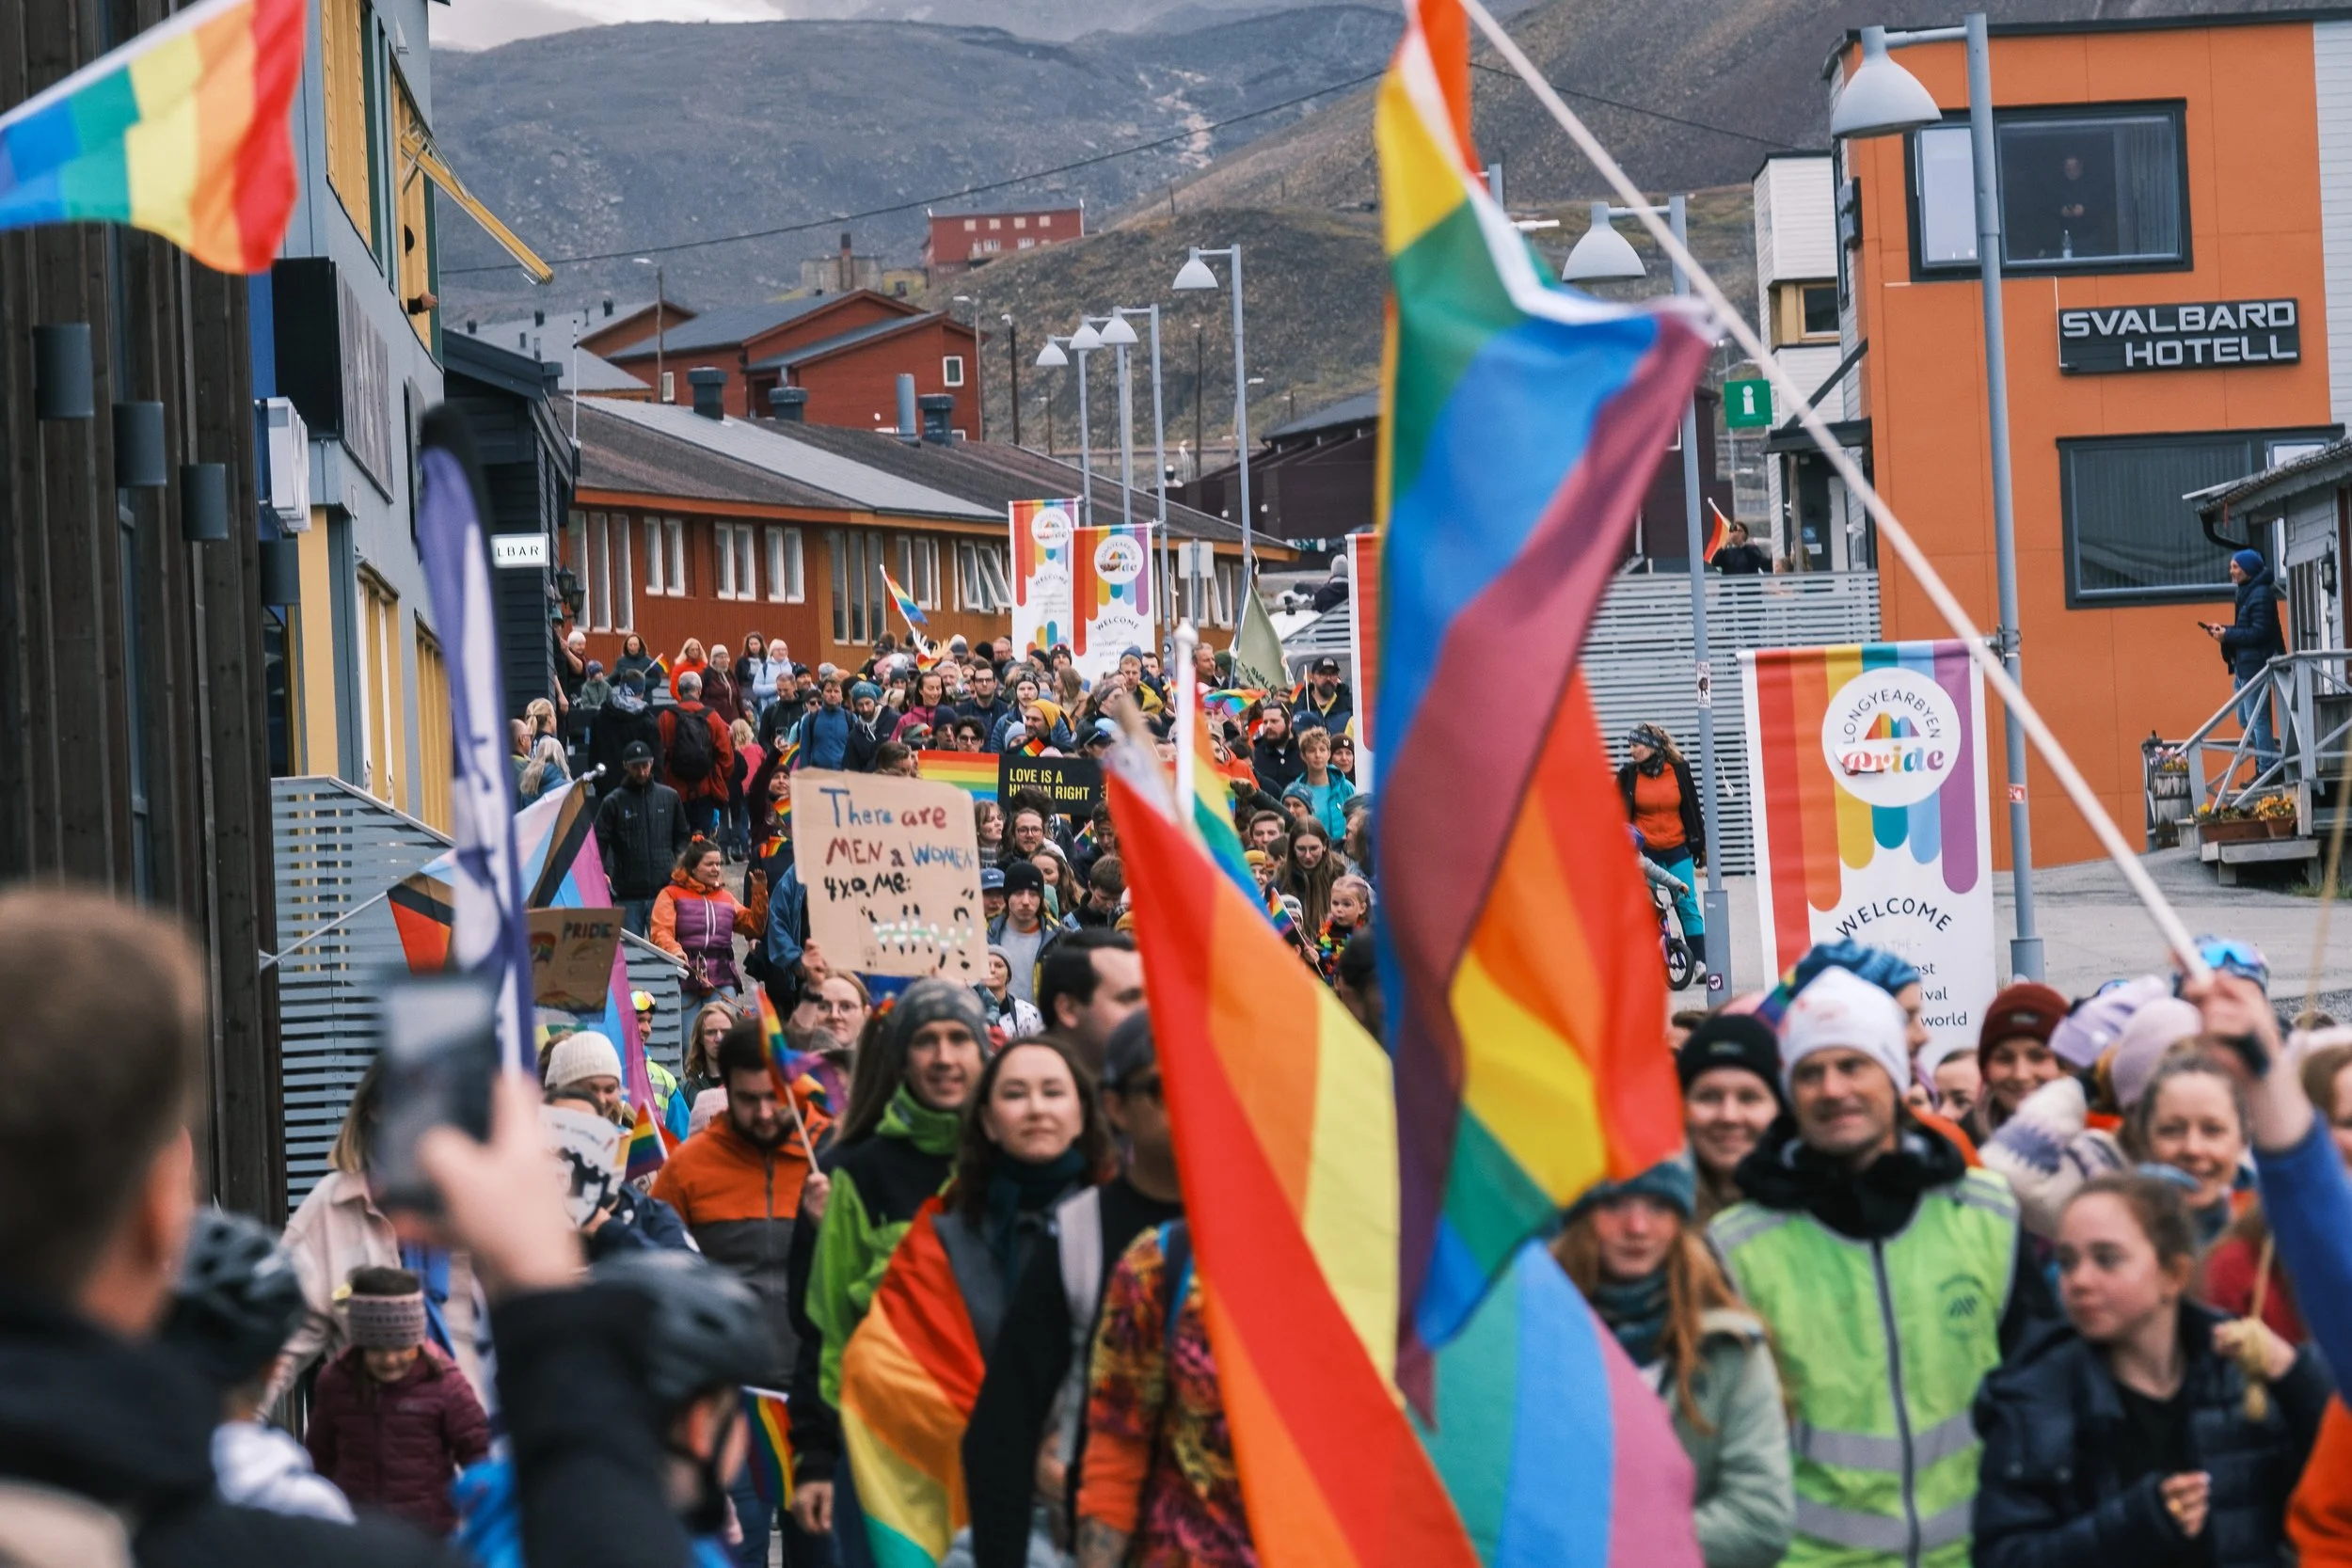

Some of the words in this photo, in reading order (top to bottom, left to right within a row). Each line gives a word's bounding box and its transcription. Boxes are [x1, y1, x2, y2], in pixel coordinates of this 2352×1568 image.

[2062, 301, 2296, 338] SVALBARD
[2125, 335, 2297, 367] HOTELL
[497, 546, 539, 558] LBAR
[1095, 615, 1139, 631] WELCOME
[1844, 689, 1942, 744] LONGYEARBYEN
[1843, 745, 1944, 776] Pride
[1009, 768, 1037, 783] LOVE
[1041, 769, 1052, 784] IS
[1056, 770, 1063, 784] A
[1055, 786, 1090, 800] RIGHT
[819, 787, 893, 828] There
[900, 806, 946, 830] are
[825, 836, 882, 865] MEN
[909, 840, 975, 870] WOMEN
[1836, 897, 1953, 939] WELCOME
[563, 921, 613, 941] PRIDE
[1920, 986, 1948, 1001] ival
[1920, 1011, 1967, 1027] world
